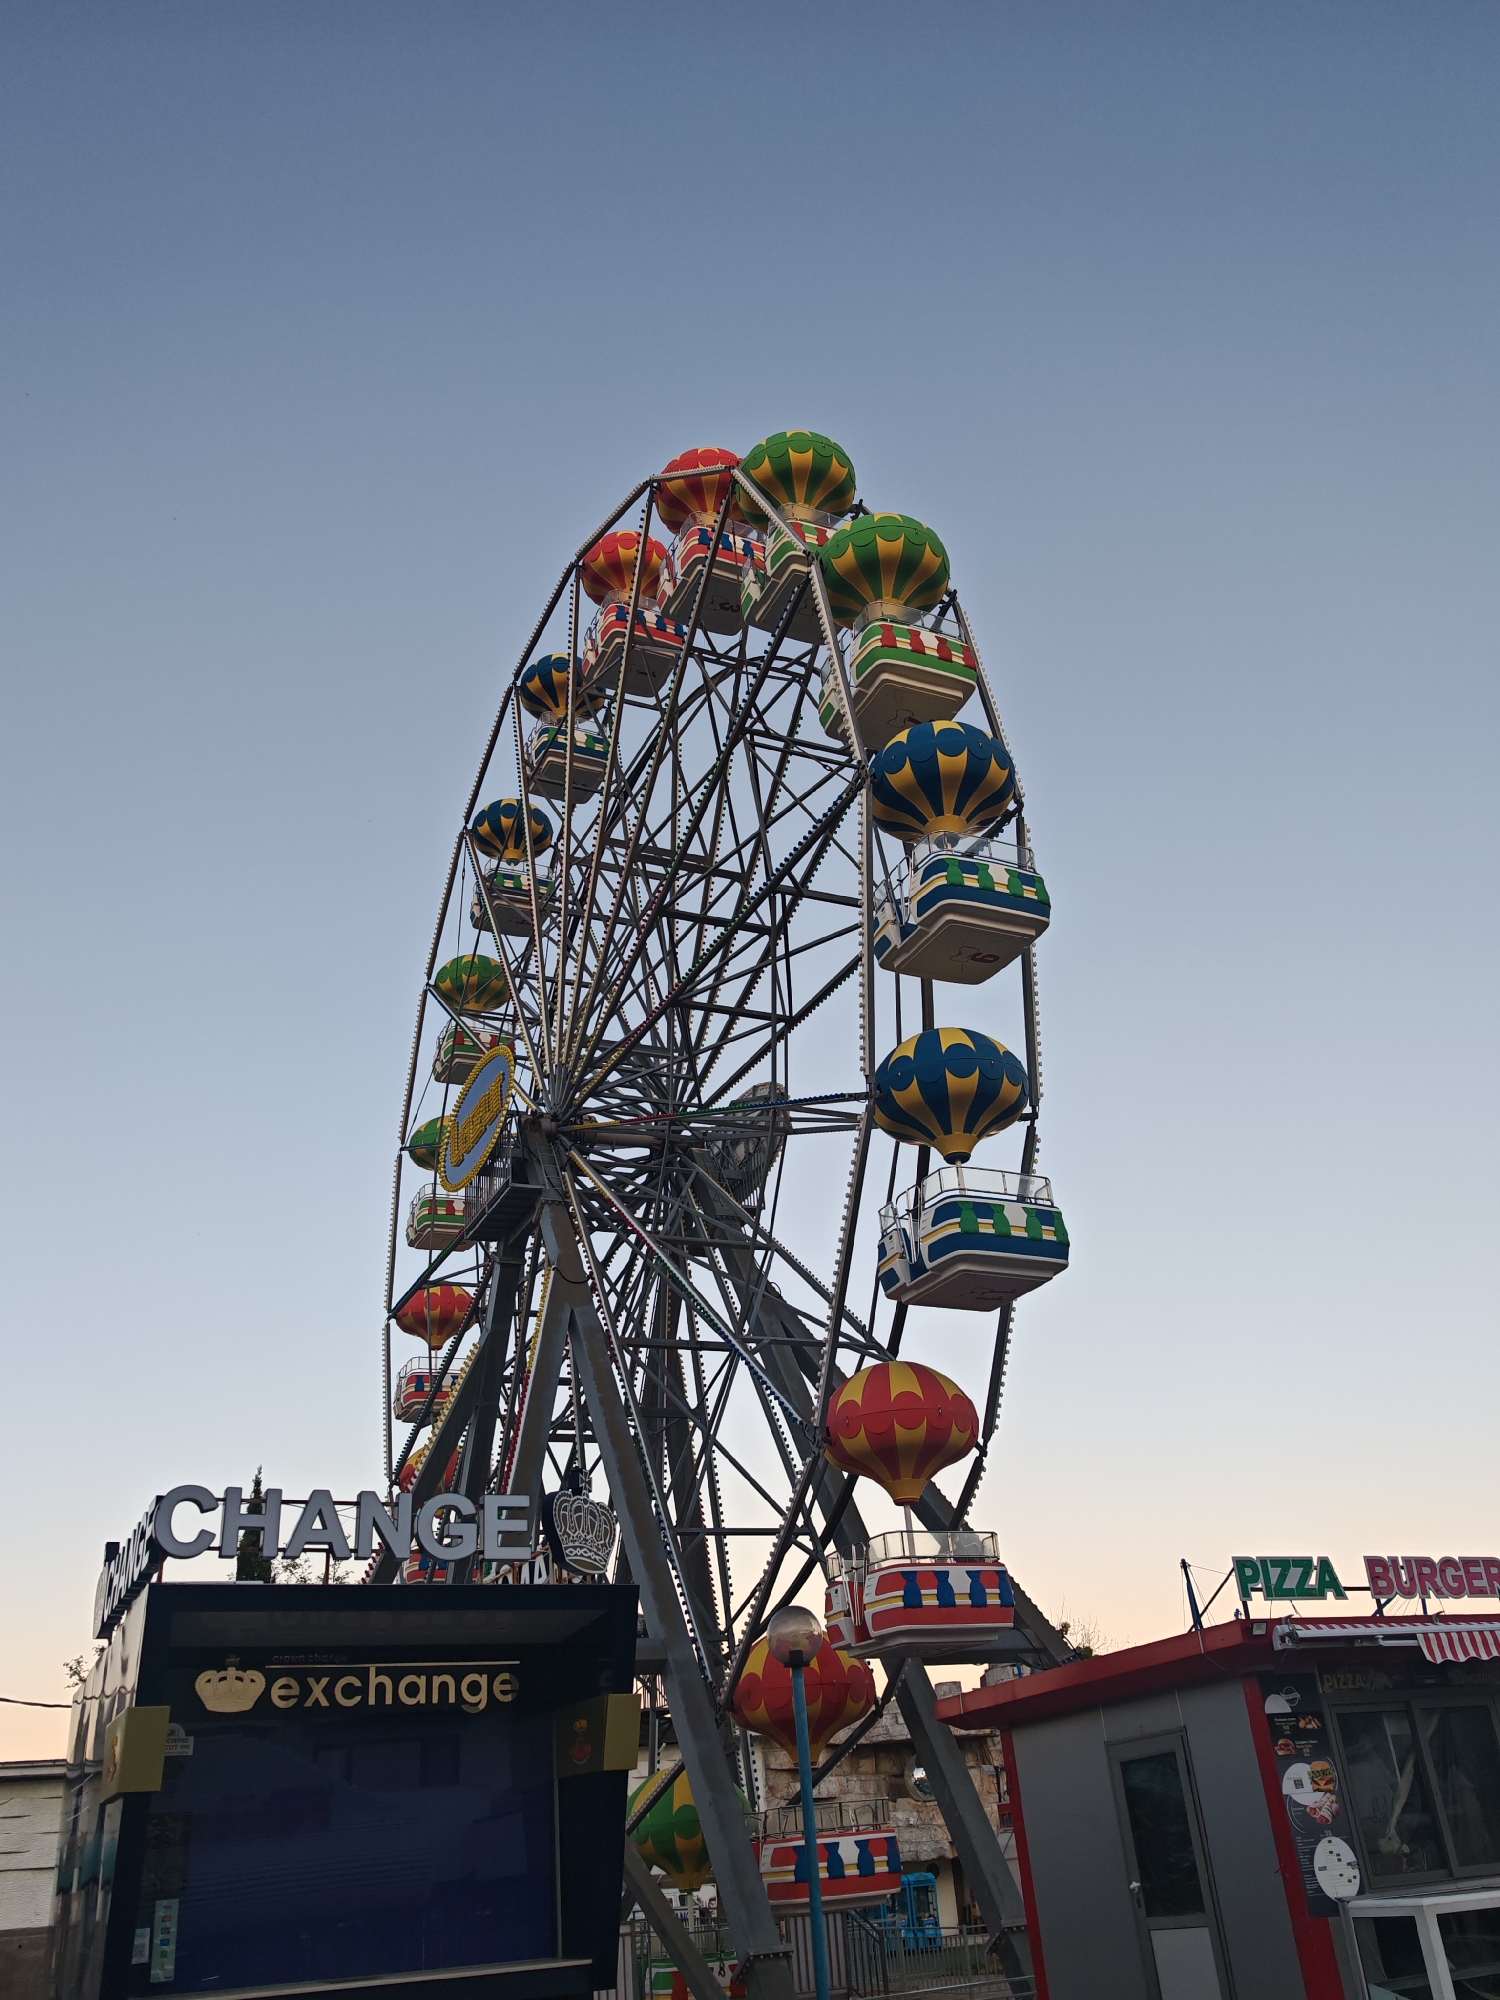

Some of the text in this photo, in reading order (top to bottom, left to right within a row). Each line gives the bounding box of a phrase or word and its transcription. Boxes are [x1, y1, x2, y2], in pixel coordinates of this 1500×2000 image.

[155, 1484, 531, 1561] CHANGE
[104, 1498, 159, 1623] CHANGE
[1233, 1556, 1500, 1600] PIZZA BURGER
[272, 1654, 305, 1663] crown
[270, 1666, 520, 1714] exchange
[1323, 1673, 1366, 1692] PIZZA
